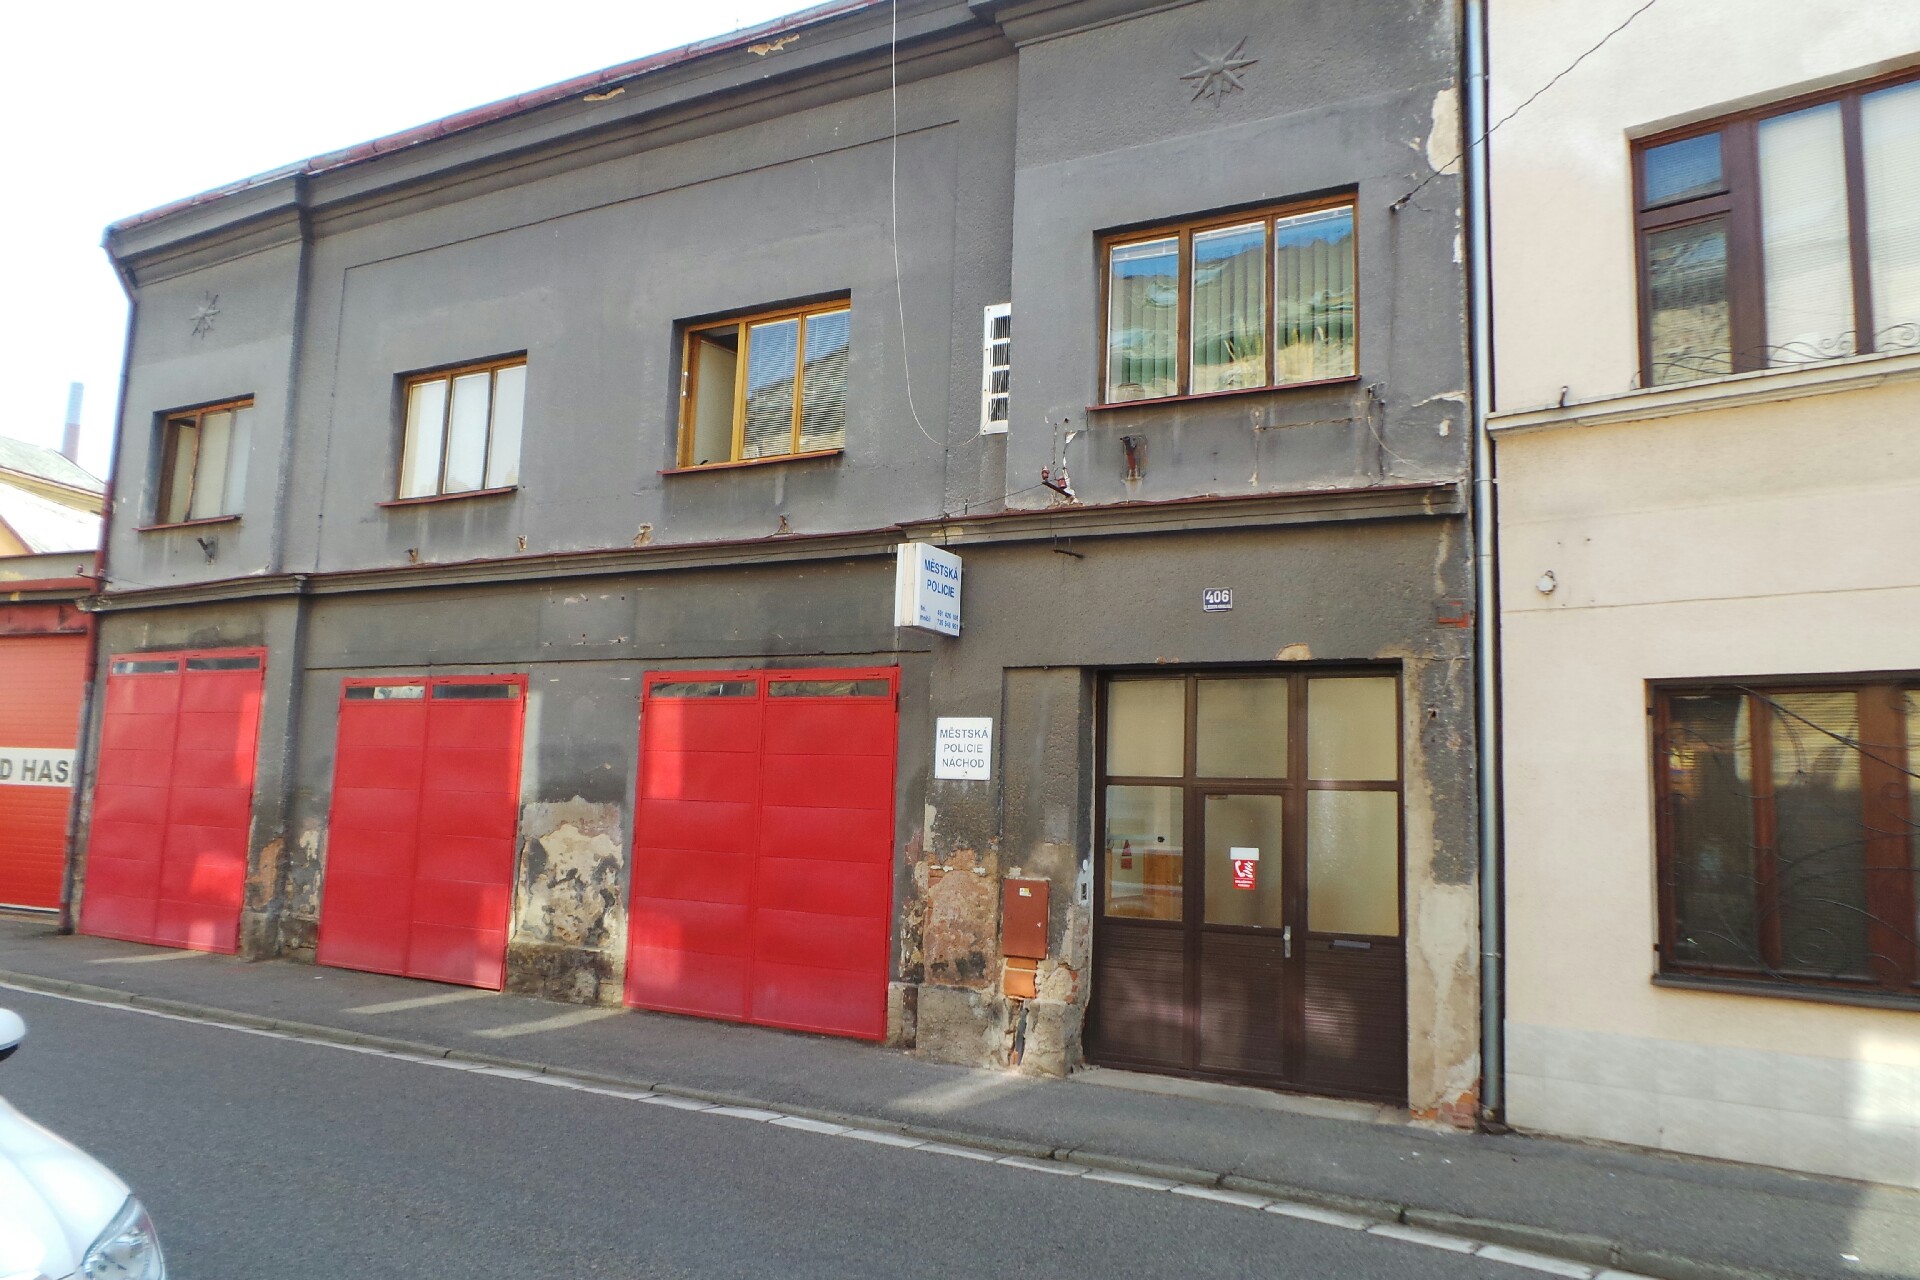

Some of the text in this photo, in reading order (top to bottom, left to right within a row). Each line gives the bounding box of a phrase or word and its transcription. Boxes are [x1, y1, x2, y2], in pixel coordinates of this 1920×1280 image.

[924, 558, 958, 581] MĚSTSKÁ
[926, 579, 955, 598] POLICIE
[1205, 590, 1230, 603] 406
[939, 726, 989, 739] MĚSTSKÁ
[943, 743, 983, 753] POLICIE
[942, 756, 985, 768] NÁCHOD
